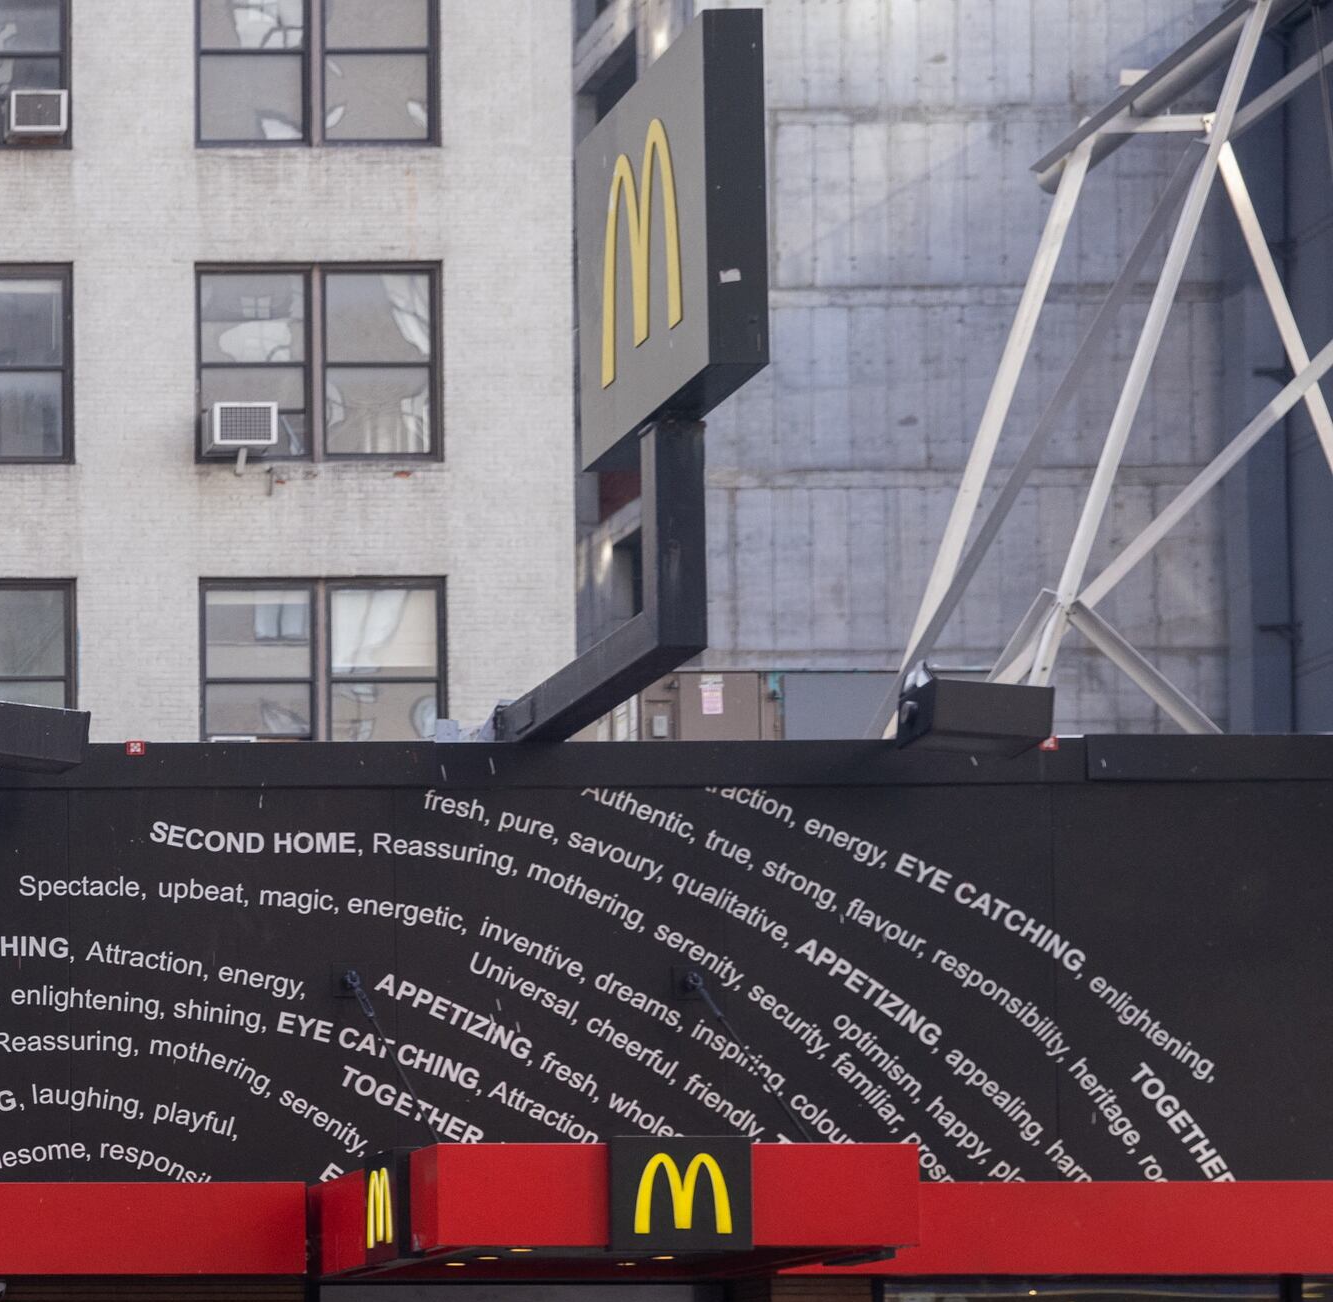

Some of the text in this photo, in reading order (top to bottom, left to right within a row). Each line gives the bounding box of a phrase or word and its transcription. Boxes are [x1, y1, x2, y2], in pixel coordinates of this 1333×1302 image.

[11, 985, 165, 1020] enlightening,
[173, 999, 268, 1033] shining,
[276, 1011, 334, 1043] EYE
[19, 875, 146, 901] Spectacle,
[158, 878, 249, 907] upbeat,
[259, 887, 340, 914] magic,
[348, 897, 468, 935] energetic,
[479, 916, 586, 984] inventive,
[595, 973, 685, 1032] dreams,
[691, 1019, 785, 1098] inspiring,
[86, 941, 209, 982] Attraction,
[218, 965, 306, 1000] energy,
[150, 821, 265, 854] SECOND
[273, 832, 364, 857] HOME,
[373, 833, 518, 876] Reassuring,
[527, 861, 645, 933] mothering,
[653, 923, 743, 992] serenity,
[747, 984, 831, 1059] security,
[831, 1052, 906, 1134] familiar,
[424, 789, 490, 826] fresh,
[498, 808, 558, 845] pure,
[568, 831, 664, 883] savoury,
[672, 871, 790, 949] qualitative,
[795, 938, 943, 1054] APPETIZING,
[944, 1048, 1043, 1146] appealing,
[581, 787, 1169, 1182] Authentic, true, strong, flavour, responsibility, heritage, ro
[804, 818, 887, 868] energy,
[894, 853, 953, 893] EYE
[954, 882, 1086, 980] CATCHING,
[1089, 976, 1214, 1083] enlightening,
[32, 1083, 145, 1120] laughing,
[153, 1100, 238, 1142] playful,
[149, 1038, 272, 1099] mothering,
[279, 1089, 369, 1158] serenity,
[340, 1065, 485, 1144] TOGETHER
[375, 972, 685, 1137] APPETIZING, fresh, whole
[469, 951, 766, 1144] Universal, cheerful, friendly,
[833, 1014, 923, 1104] optimism,
[925, 1095, 992, 1165] happy,
